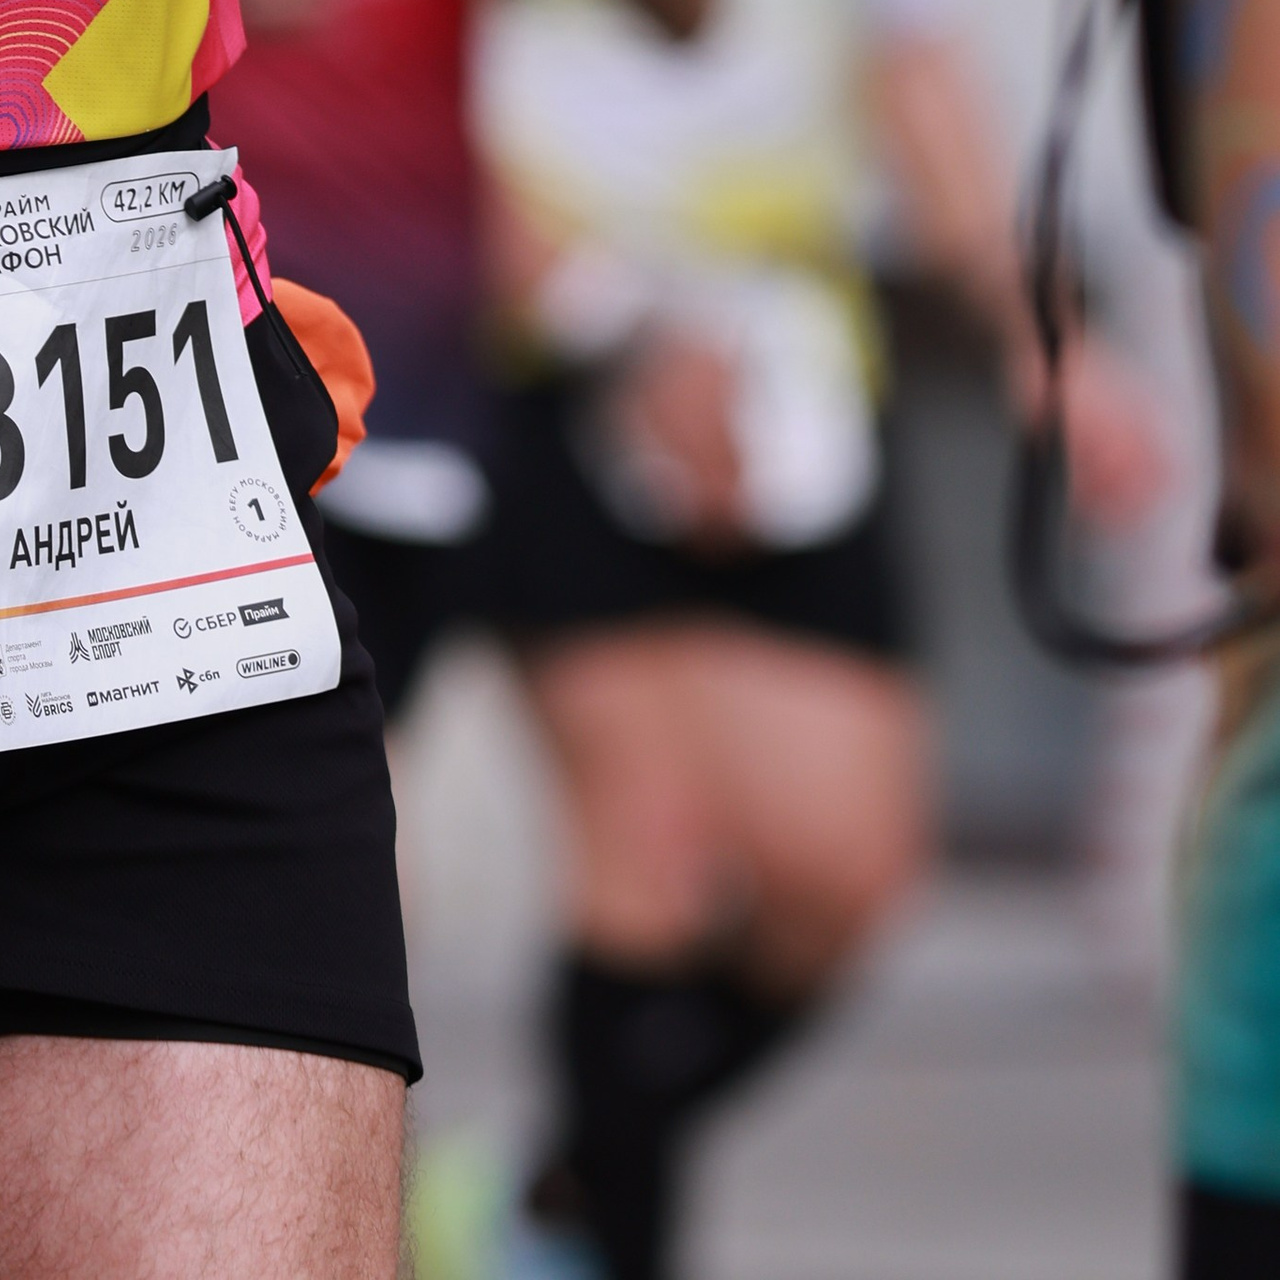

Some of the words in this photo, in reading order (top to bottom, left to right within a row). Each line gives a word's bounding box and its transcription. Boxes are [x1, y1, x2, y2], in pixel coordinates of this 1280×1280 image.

[114, 185, 152, 213] 42,2
[159, 180, 186, 206] КМ
[239, 477, 287, 531] МОСКОВСКИЙ
[247, 497, 265, 522] 1
[9, 500, 140, 571] АНДРЕЙ
[233, 515, 280, 543] МАРАФОН
[87, 616, 153, 644] МОСКОВСКИЙ
[195, 611, 238, 632] СБЕР
[243, 605, 280, 622] Прайм
[91, 641, 123, 660] СПОРТ
[199, 670, 221, 683] сбп
[241, 655, 287, 675] WINLINE
[43, 701, 74, 717] BRICS
